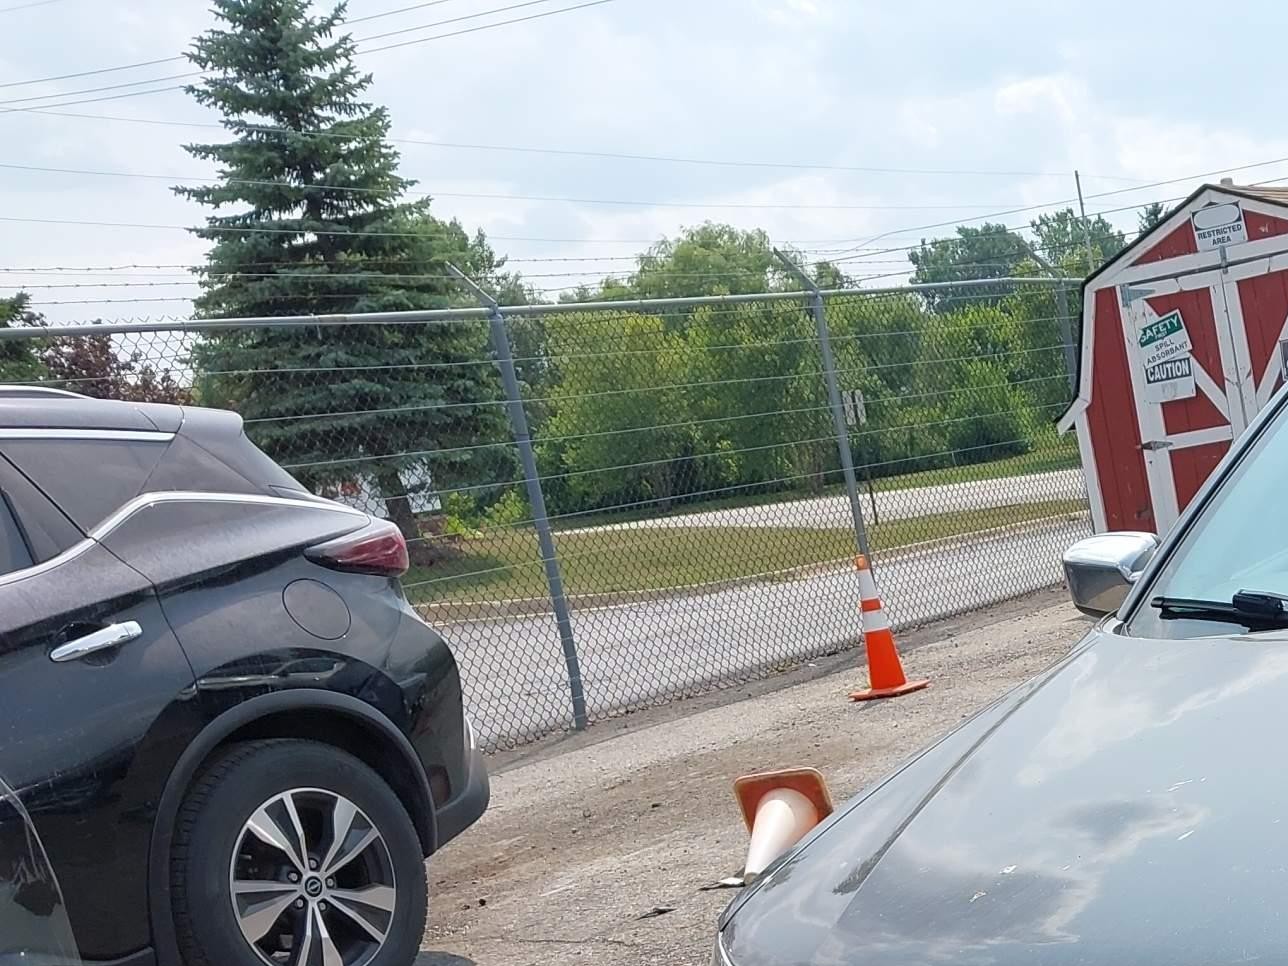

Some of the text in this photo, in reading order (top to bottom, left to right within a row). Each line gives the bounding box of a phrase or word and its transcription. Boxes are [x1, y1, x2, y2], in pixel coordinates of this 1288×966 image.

[1197, 223, 1242, 240] RESTRICTED
[1212, 235, 1232, 246] AREA
[1139, 315, 1178, 343] SAFETY
[1146, 341, 1188, 365] ABSORBANT
[1154, 338, 1175, 352] SPILL
[1147, 359, 1190, 382] CAUTION
